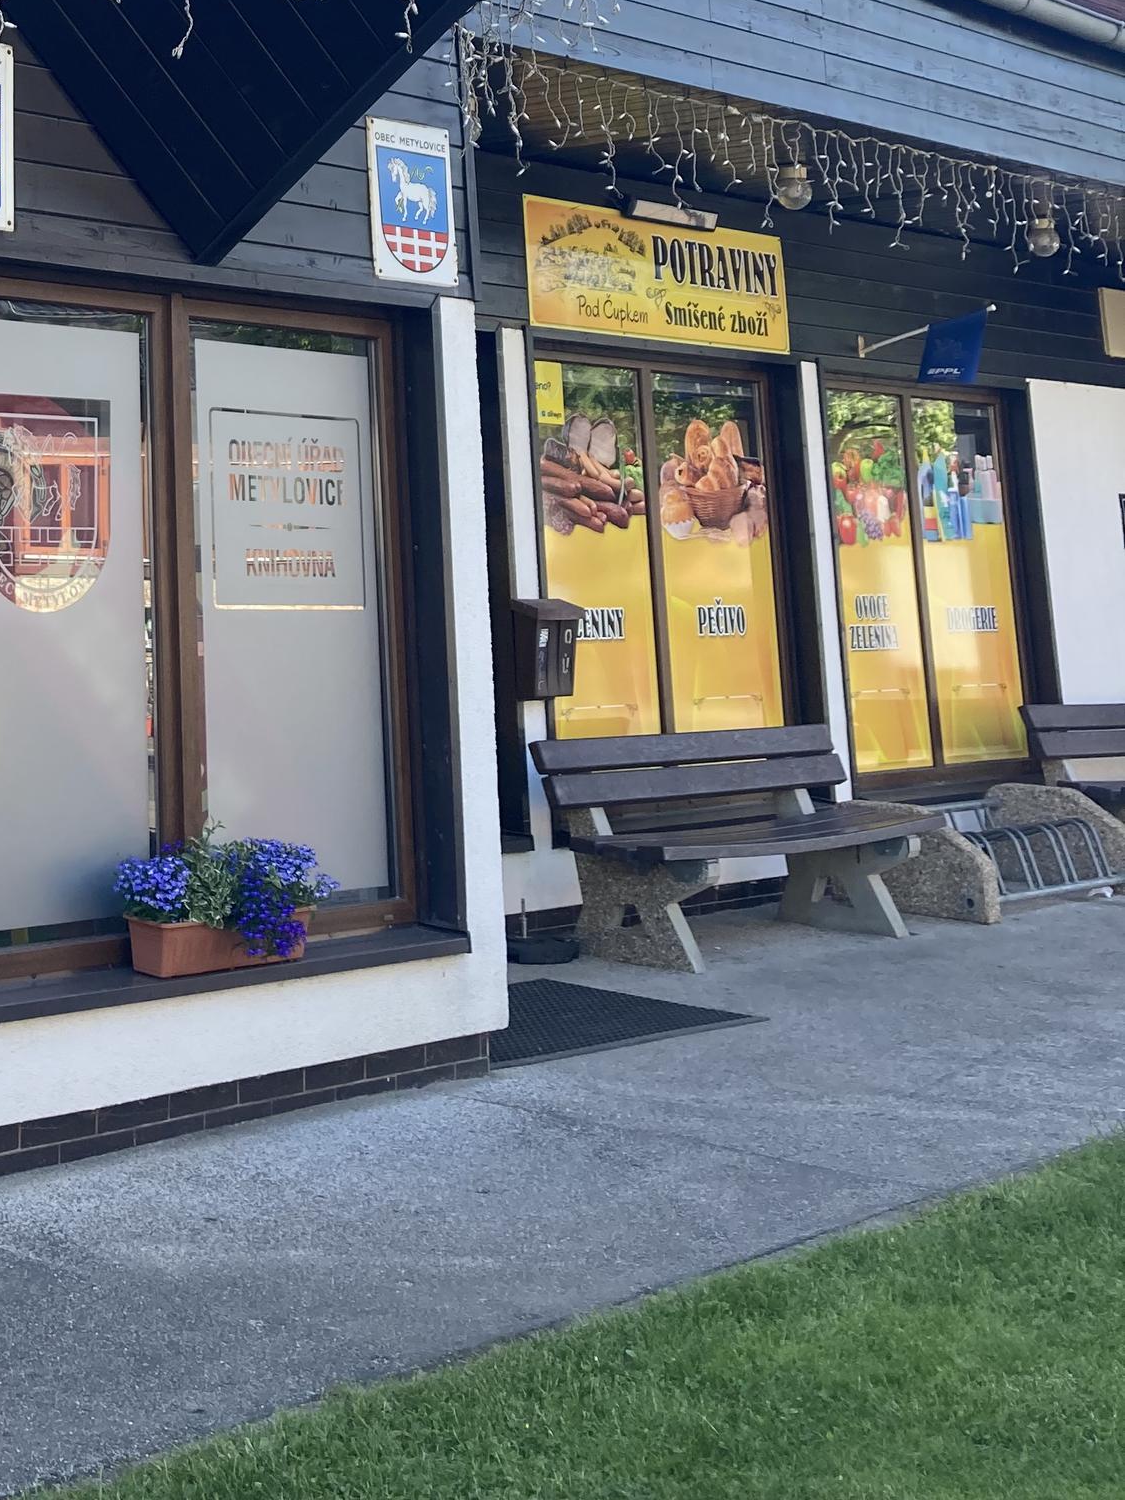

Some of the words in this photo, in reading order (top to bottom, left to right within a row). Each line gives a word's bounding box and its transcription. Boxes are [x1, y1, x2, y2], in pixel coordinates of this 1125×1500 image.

[374, 131, 396, 144] OBEC
[399, 136, 446, 153] METYLOVICE
[651, 234, 779, 298] POTRAVINY
[577, 294, 600, 319] Pod
[603, 293, 648, 331] Čupkem
[665, 301, 726, 332] Smíšené
[730, 311, 769, 337] zboží
[228, 437, 292, 471] OBECNÍ
[297, 437, 346, 473] ÚŘAD
[228, 473, 346, 506] METYLOVICE
[245, 547, 336, 578] KNIHOVNA
[696, 598, 747, 637] PEČIVO
[854, 594, 890, 621] OVOCE
[946, 605, 998, 632] DROGERIE
[849, 625, 899, 651] ZELENINA
